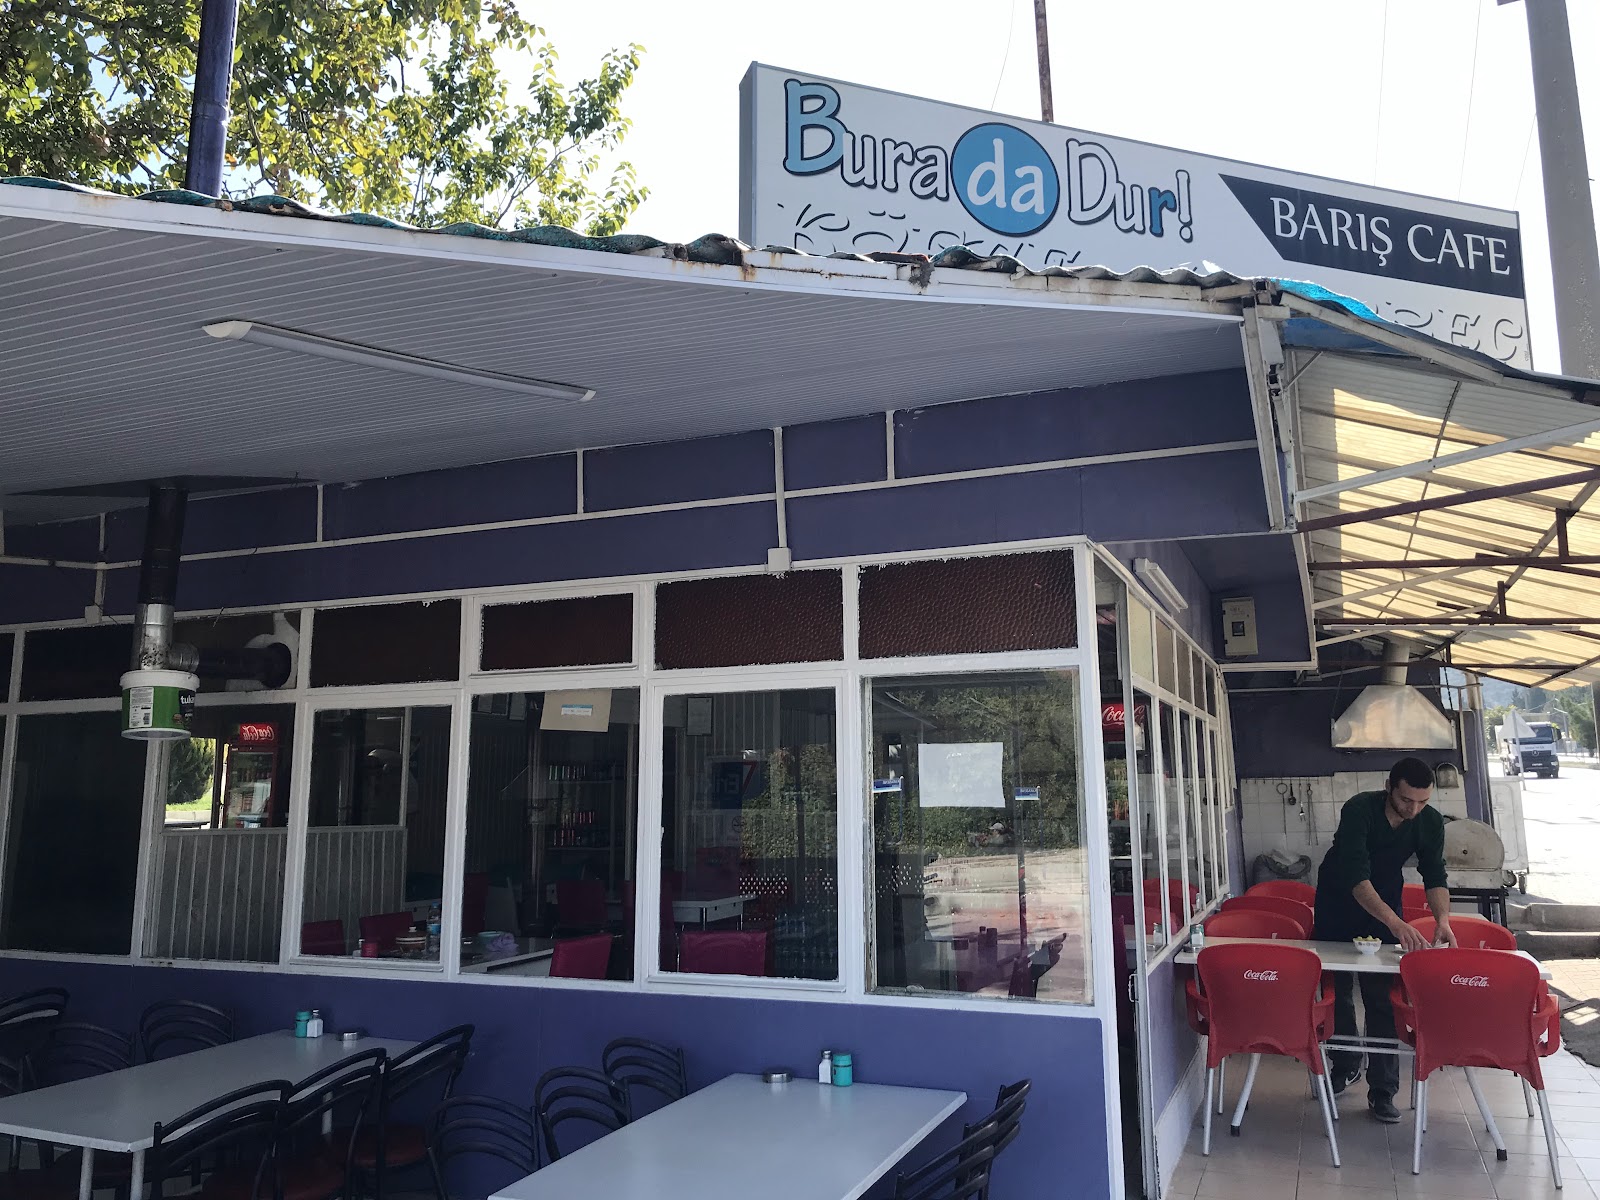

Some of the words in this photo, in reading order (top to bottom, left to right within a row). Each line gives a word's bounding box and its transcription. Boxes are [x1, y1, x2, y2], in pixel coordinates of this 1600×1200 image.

[1066, 138, 1193, 242] Dur!
[1270, 197, 1393, 266] BARIŞ
[1408, 224, 1510, 276] CAFE
[1243, 969, 1279, 981] Coca-Cola
[1450, 974, 1490, 988] Coca-Cola
